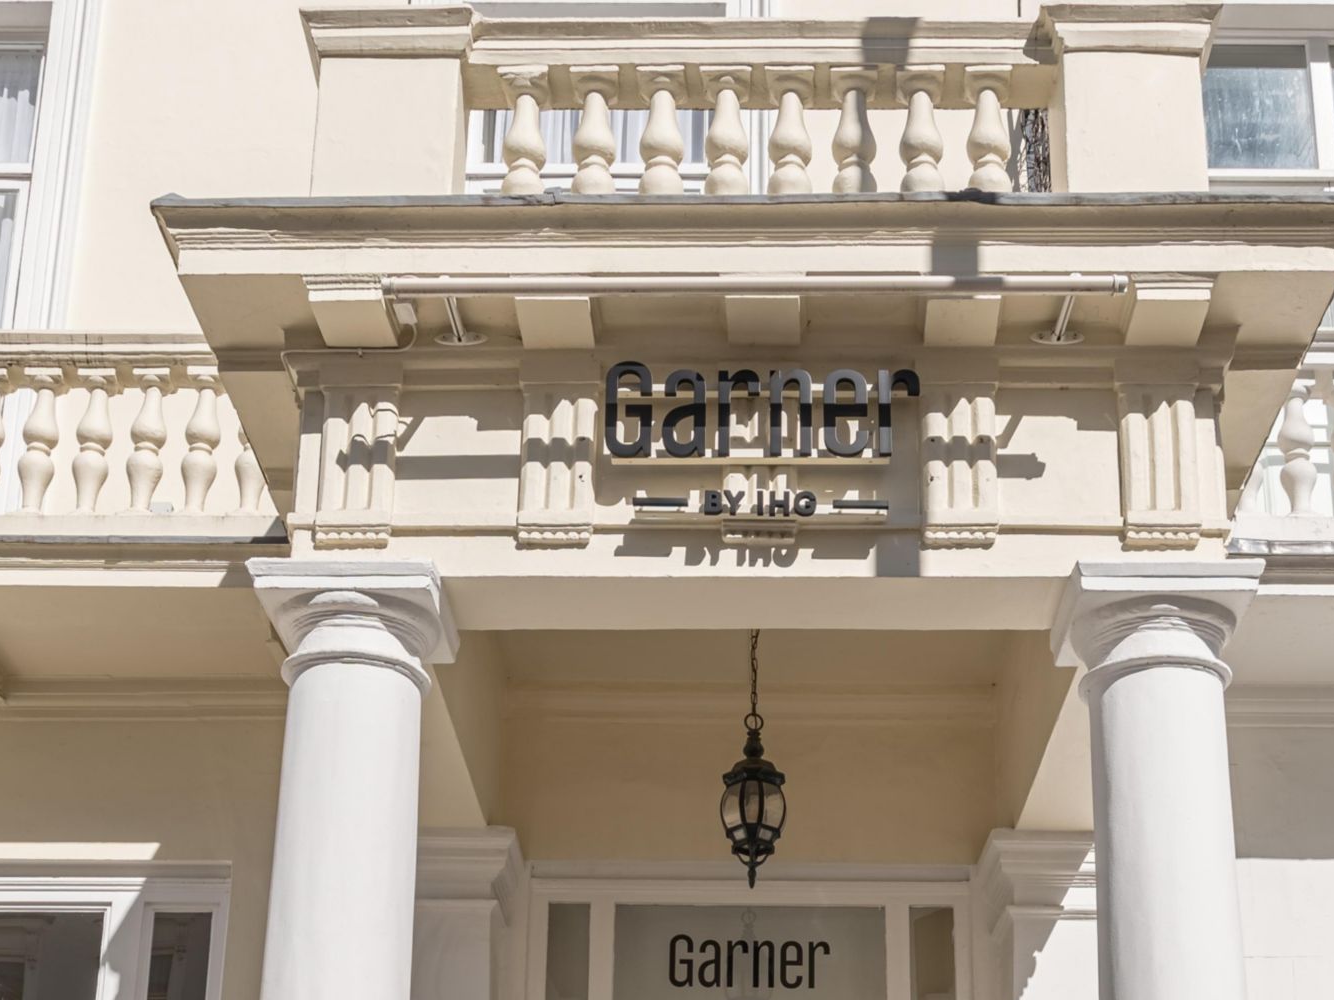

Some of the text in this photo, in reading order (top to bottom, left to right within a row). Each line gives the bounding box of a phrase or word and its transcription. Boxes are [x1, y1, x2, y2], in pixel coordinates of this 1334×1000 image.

[605, 360, 921, 458] Garner
[703, 490, 818, 517] BY IHG
[668, 933, 831, 989] Garner
